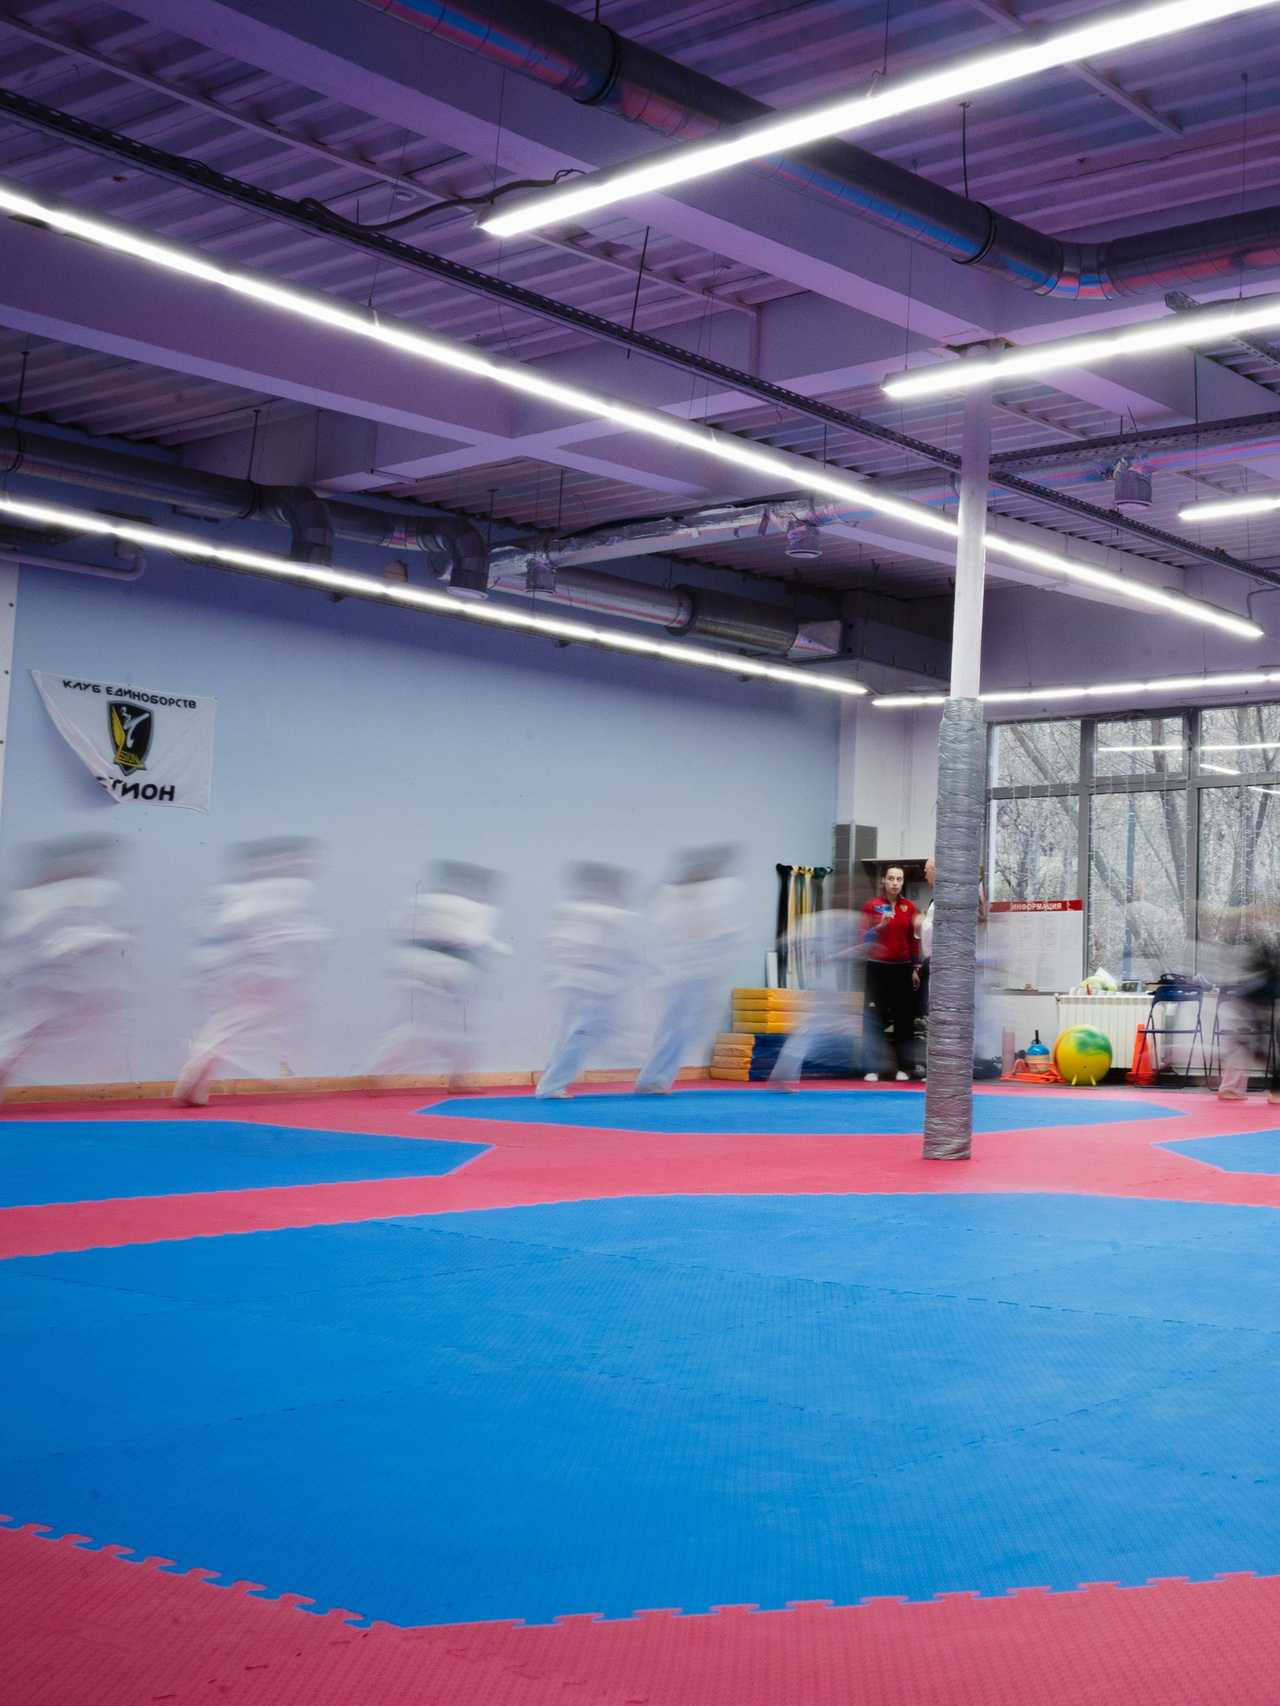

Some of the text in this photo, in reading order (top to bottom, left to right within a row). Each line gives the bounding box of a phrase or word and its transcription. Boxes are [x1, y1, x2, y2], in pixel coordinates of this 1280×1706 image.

[62, 679, 197, 709] КЛУБ ЕДИНОБОРСТВ
[1011, 902, 1062, 911] ИНФОРМАЦИЯ
